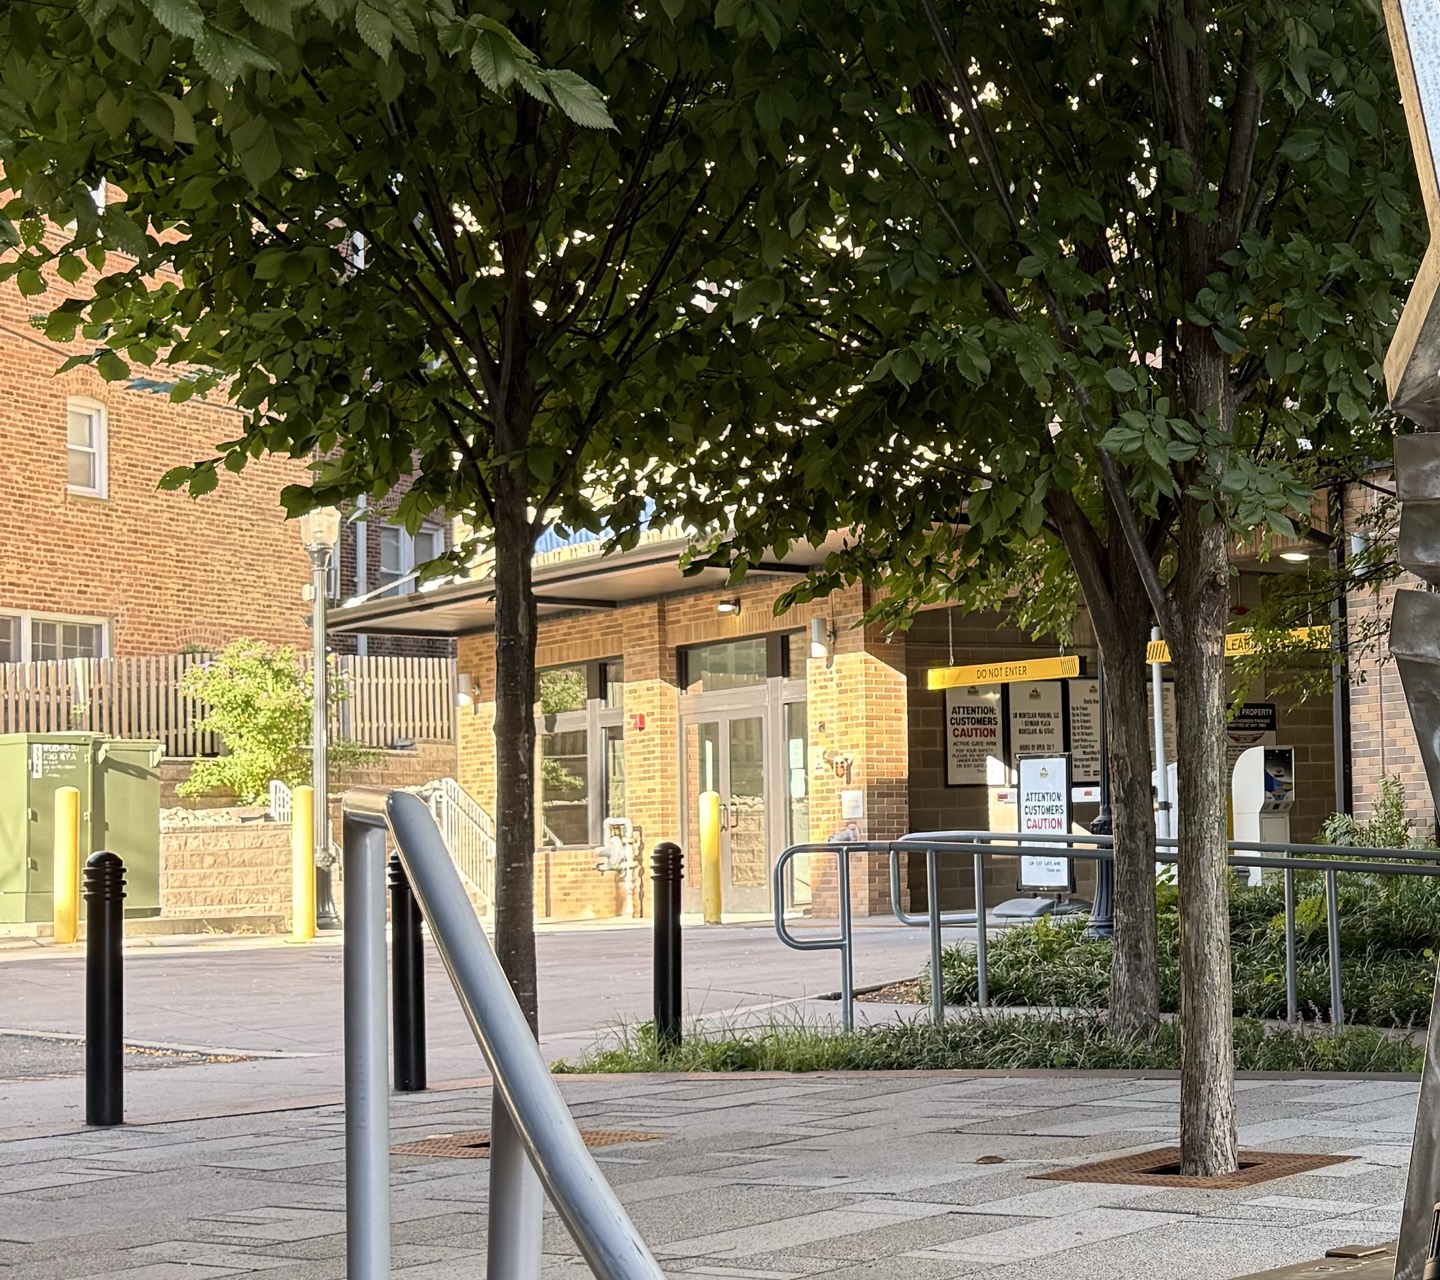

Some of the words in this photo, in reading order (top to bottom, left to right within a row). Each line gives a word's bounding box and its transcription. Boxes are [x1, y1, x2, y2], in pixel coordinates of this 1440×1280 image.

[976, 669, 986, 679] DO
[988, 668, 1003, 678] NOT
[1005, 666, 1028, 677] ENTER
[951, 706, 996, 716] ATTENTION:
[1241, 708, 1272, 716] PROPERTY
[950, 717, 998, 726] CUSTOMERS
[952, 728, 996, 738] CAUTION
[1025, 791, 1063, 802] ATTENTION:
[1024, 805, 1064, 815] CUSTOMERS
[1026, 818, 1063, 829] CAUTION
